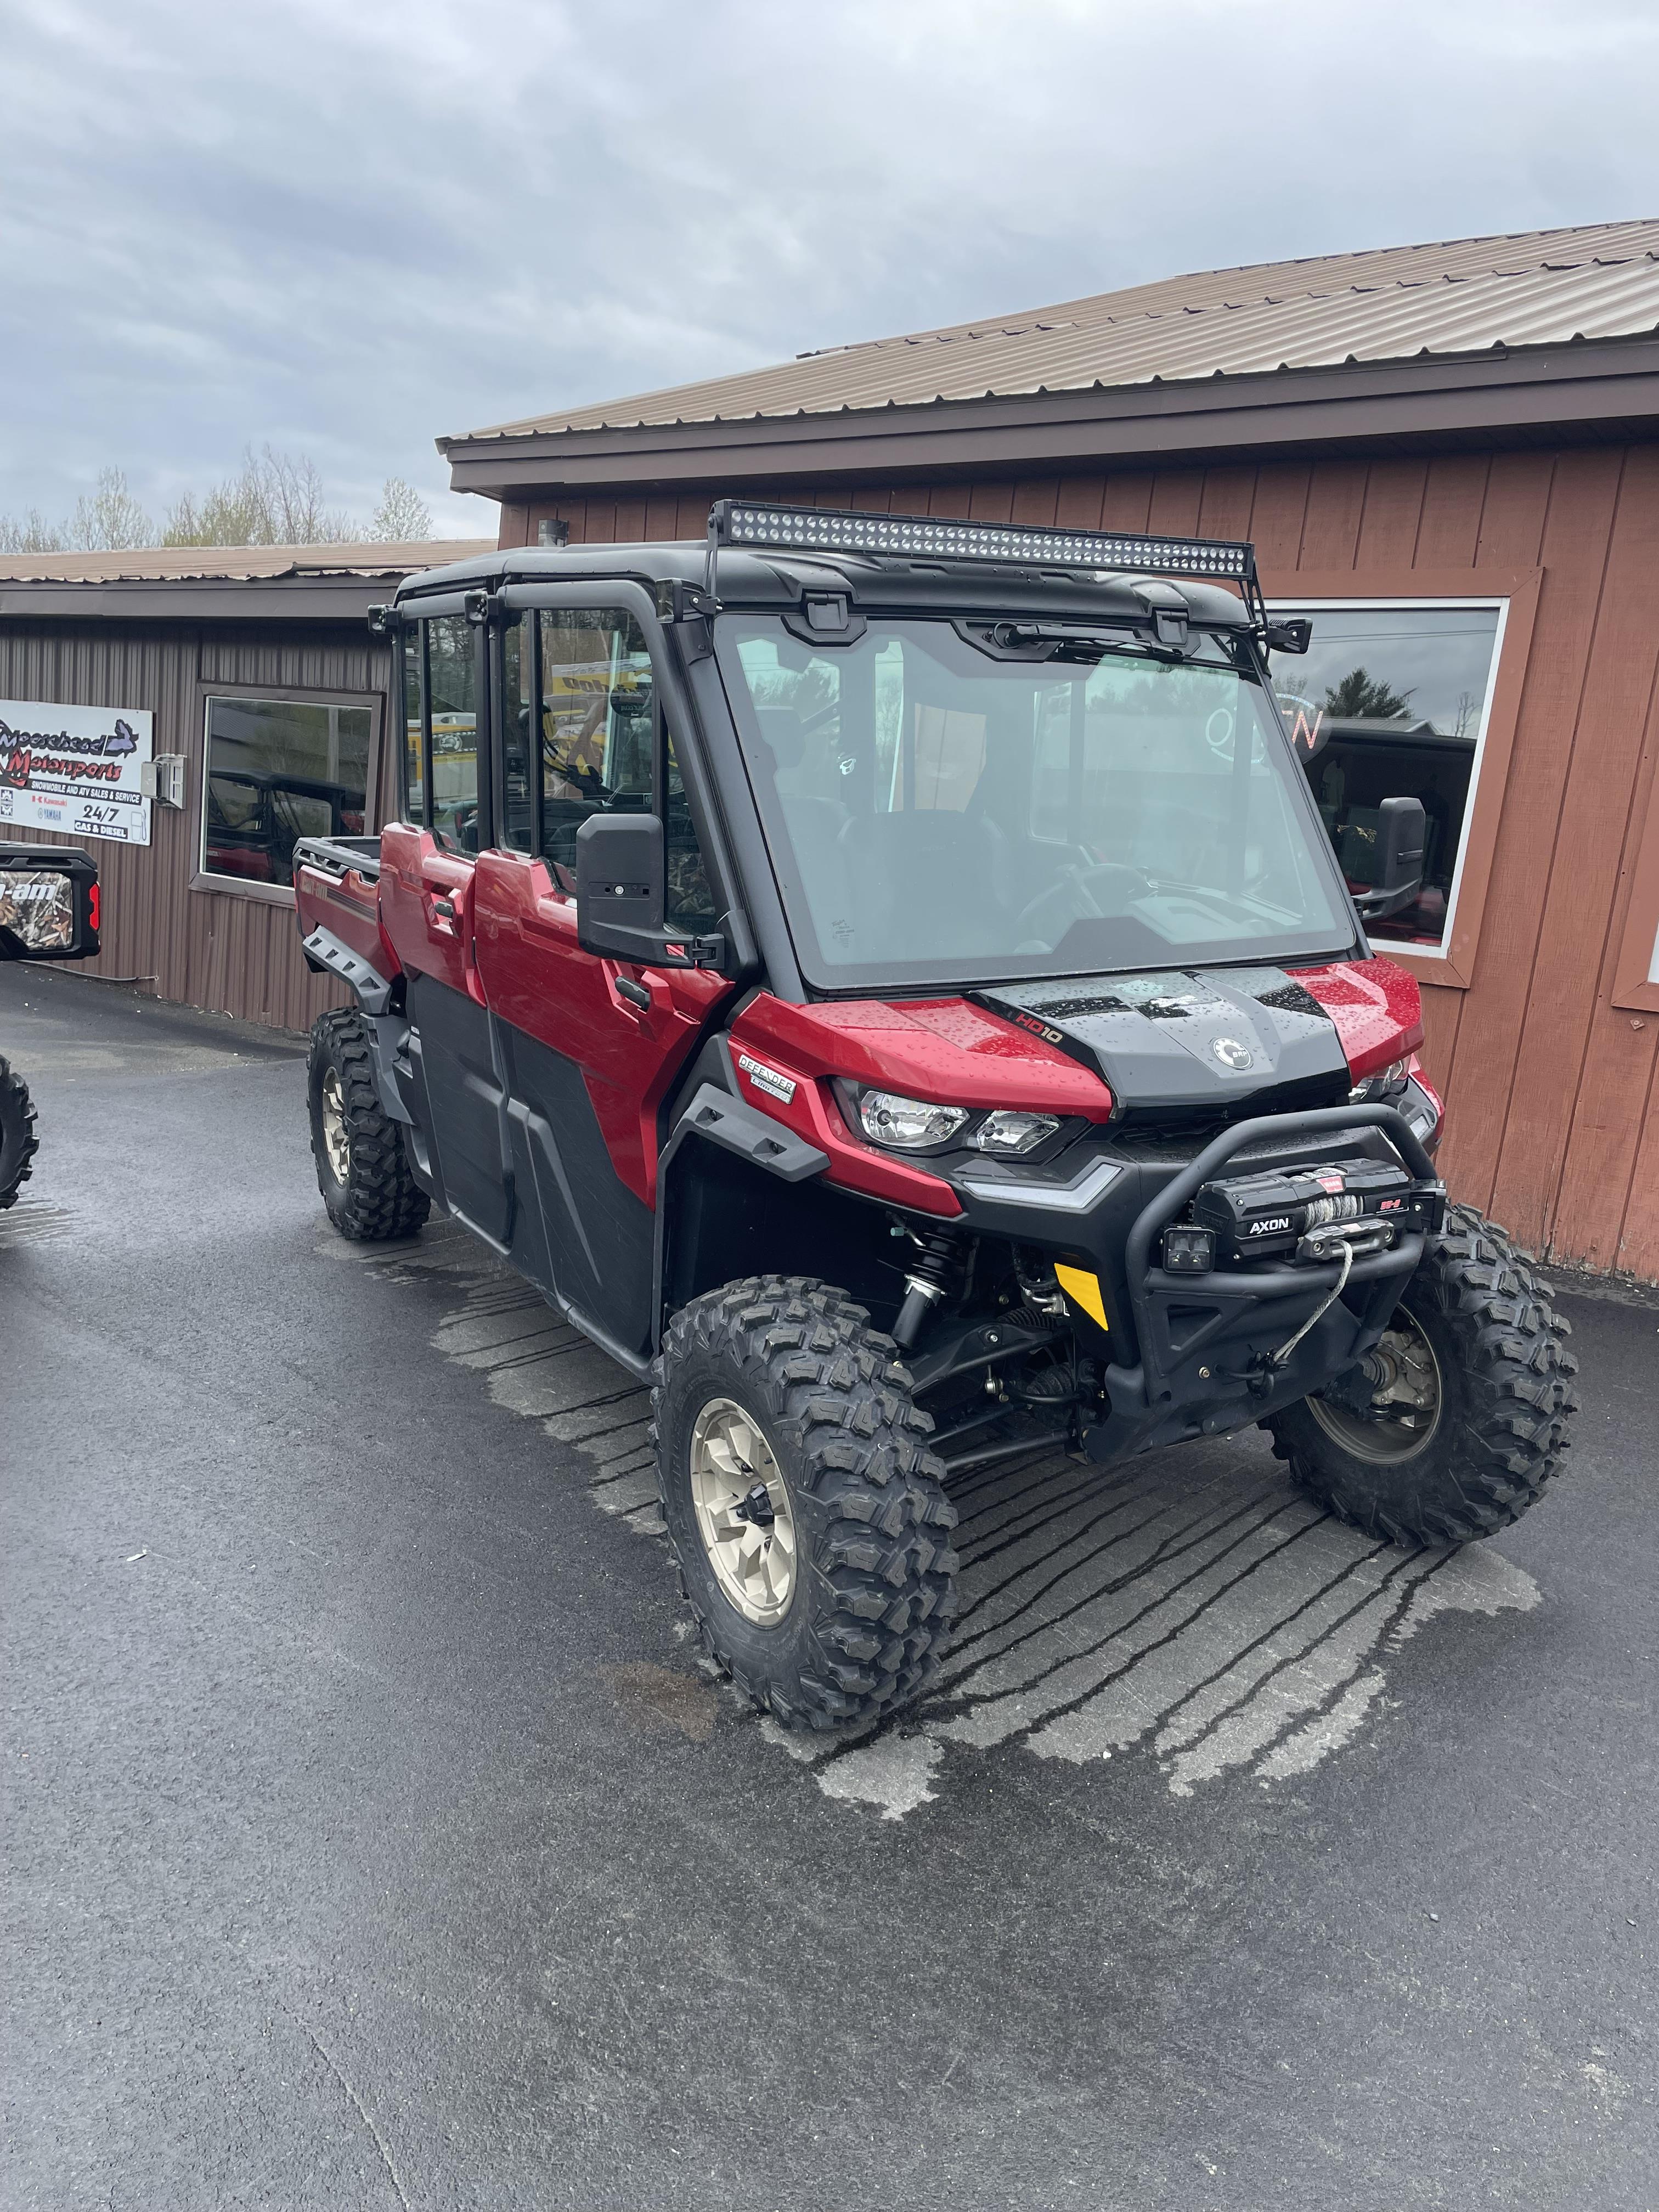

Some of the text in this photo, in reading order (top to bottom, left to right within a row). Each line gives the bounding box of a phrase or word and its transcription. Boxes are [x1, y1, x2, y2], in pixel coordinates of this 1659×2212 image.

[6, 747, 122, 781] Motorsports
[31, 781, 65, 793] SNOWMOBILE
[66, 787, 78, 795] AND
[79, 787, 91, 797] ATV
[91, 789, 108, 799] SALES
[115, 792, 140, 803] SERVICE
[43, 797, 67, 807] Kawasaki
[43, 809, 61, 821] YAMAHA
[83, 805, 120, 822] 24/7
[75, 822, 91, 832] GAS
[101, 826, 126, 838] DIESEL
[1015, 1013, 1063, 1043] HD10
[740, 1057, 793, 1092] DEFENDER
[1249, 1217, 1289, 1234] AXON
